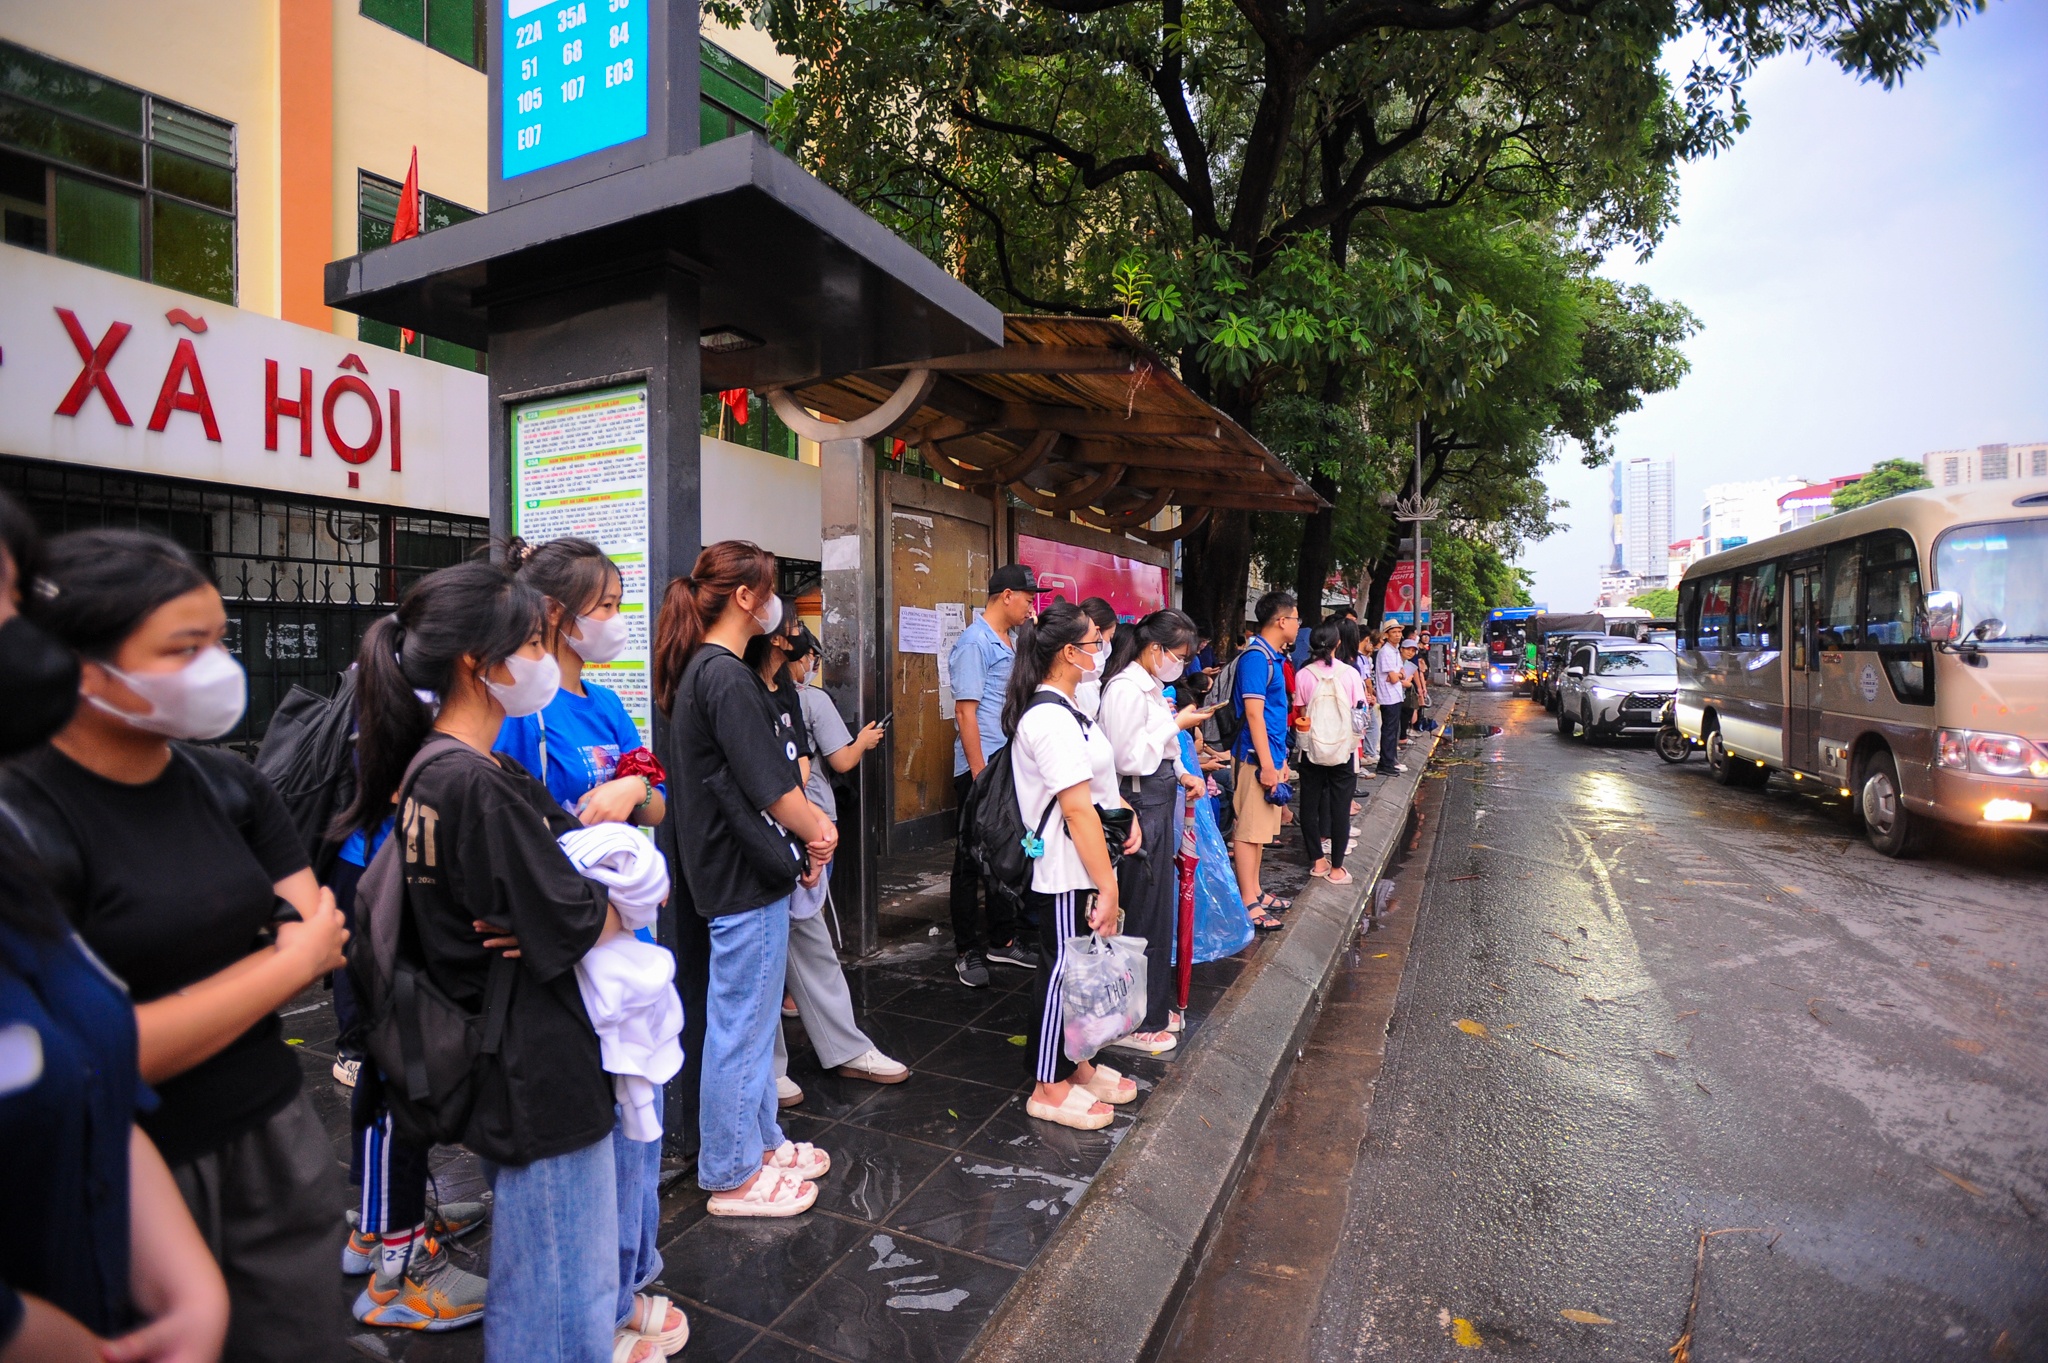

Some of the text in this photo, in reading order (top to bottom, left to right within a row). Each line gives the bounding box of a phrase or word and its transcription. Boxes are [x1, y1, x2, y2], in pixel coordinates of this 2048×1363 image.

[516, 20, 542, 49] 22A
[557, 2, 587, 33] 35A
[521, 22, 630, 81] 51 68 84
[517, 58, 634, 114] 105 107 E03
[518, 124, 542, 151] E07
[54, 307, 402, 489] XÃ HỘI
